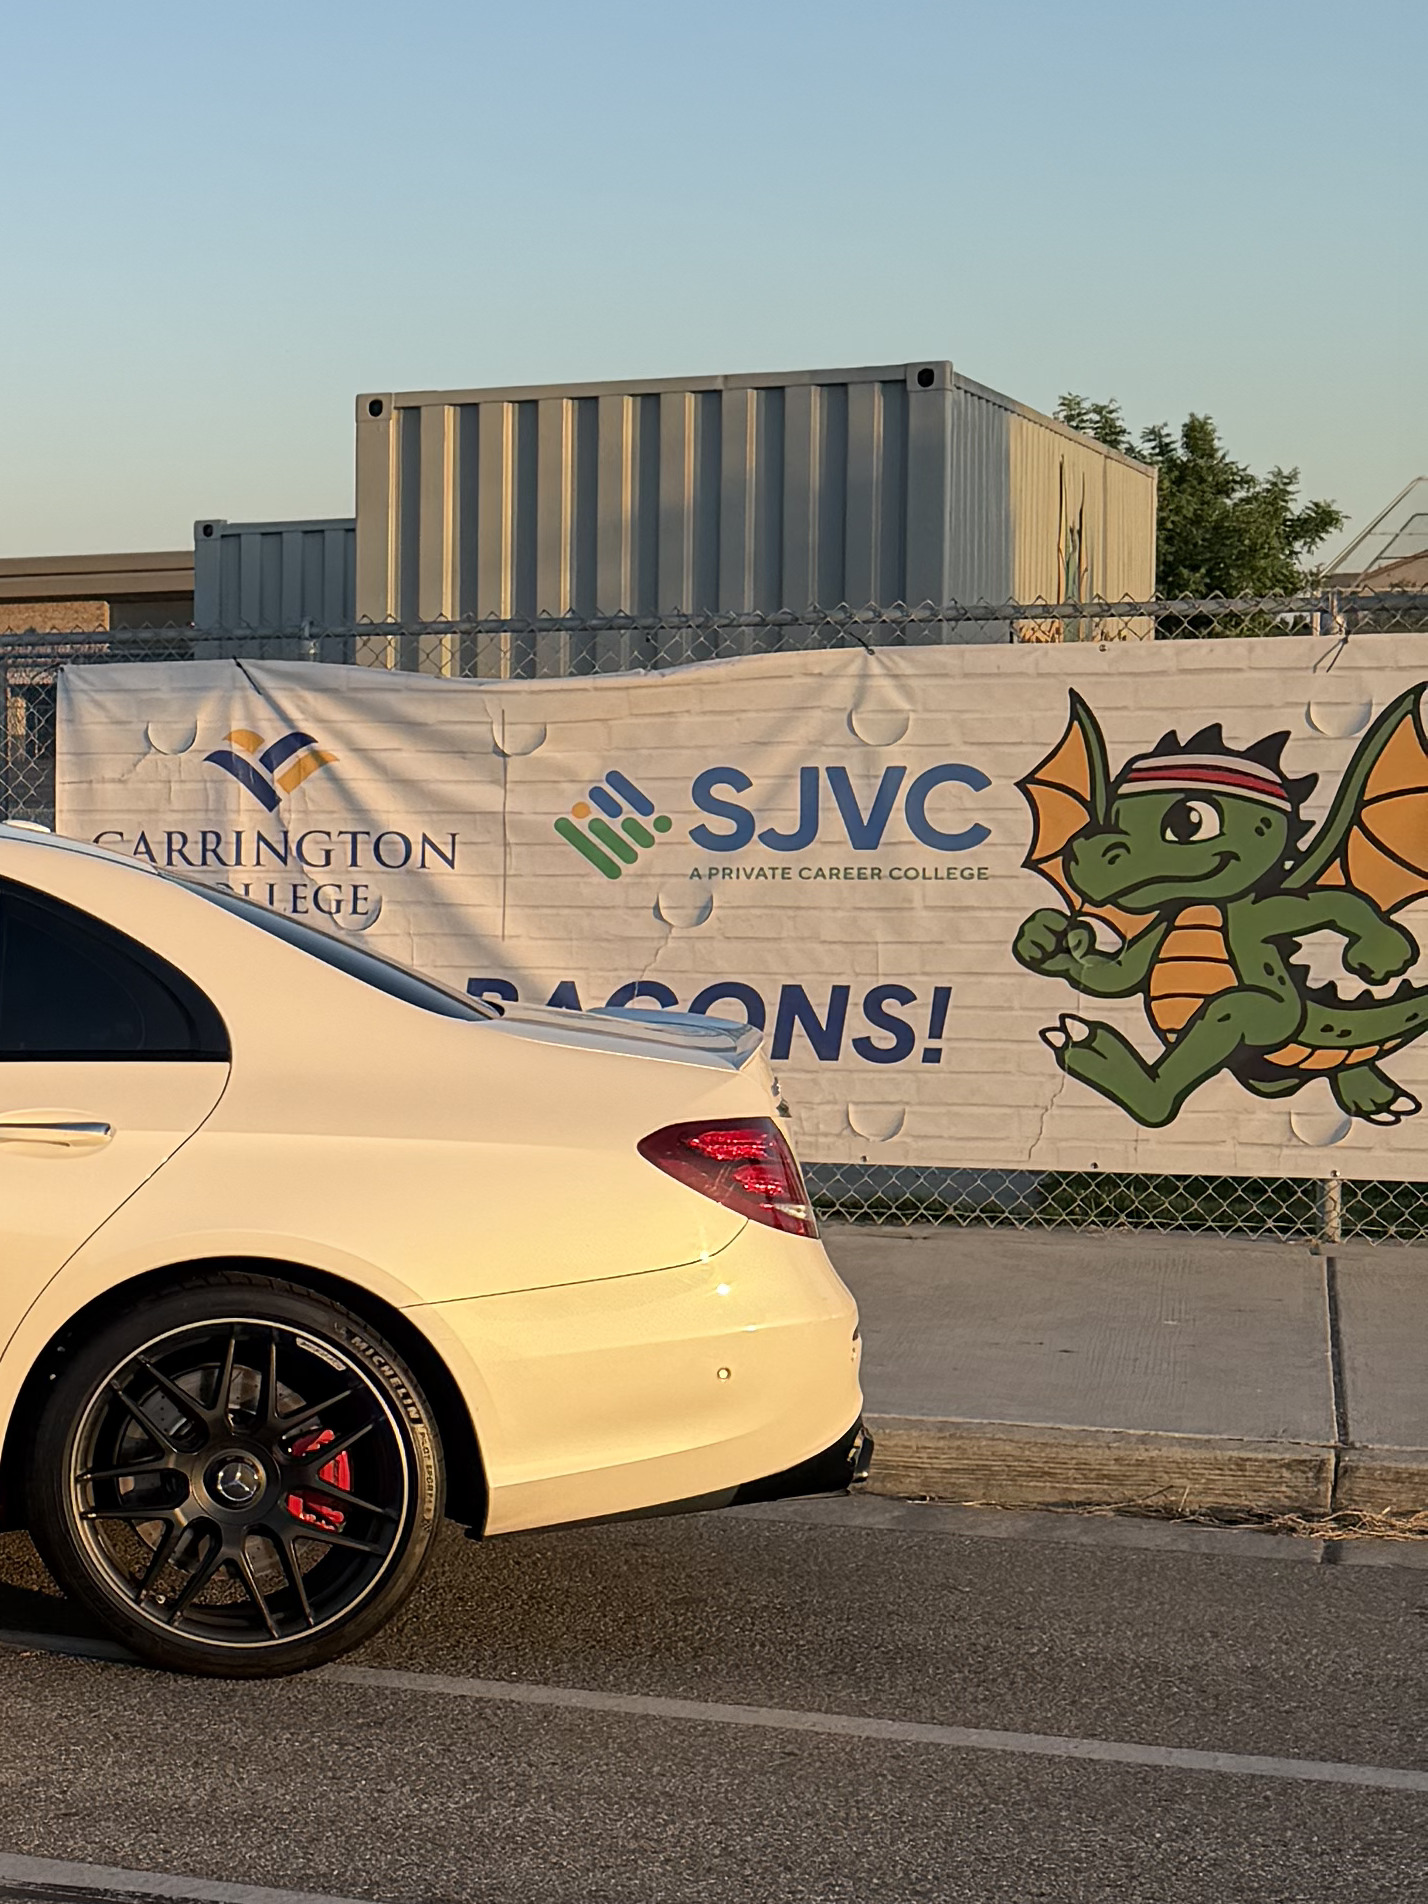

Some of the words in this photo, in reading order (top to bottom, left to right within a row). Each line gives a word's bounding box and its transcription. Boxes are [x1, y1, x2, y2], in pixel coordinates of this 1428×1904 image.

[688, 763, 993, 852] SJVC
[689, 867, 702, 880] A
[708, 867, 792, 880] PRIVATE
[798, 867, 882, 880] CAREER
[888, 867, 989, 880] COLLEGE
[351, 1336, 420, 1419] MICHELIN
